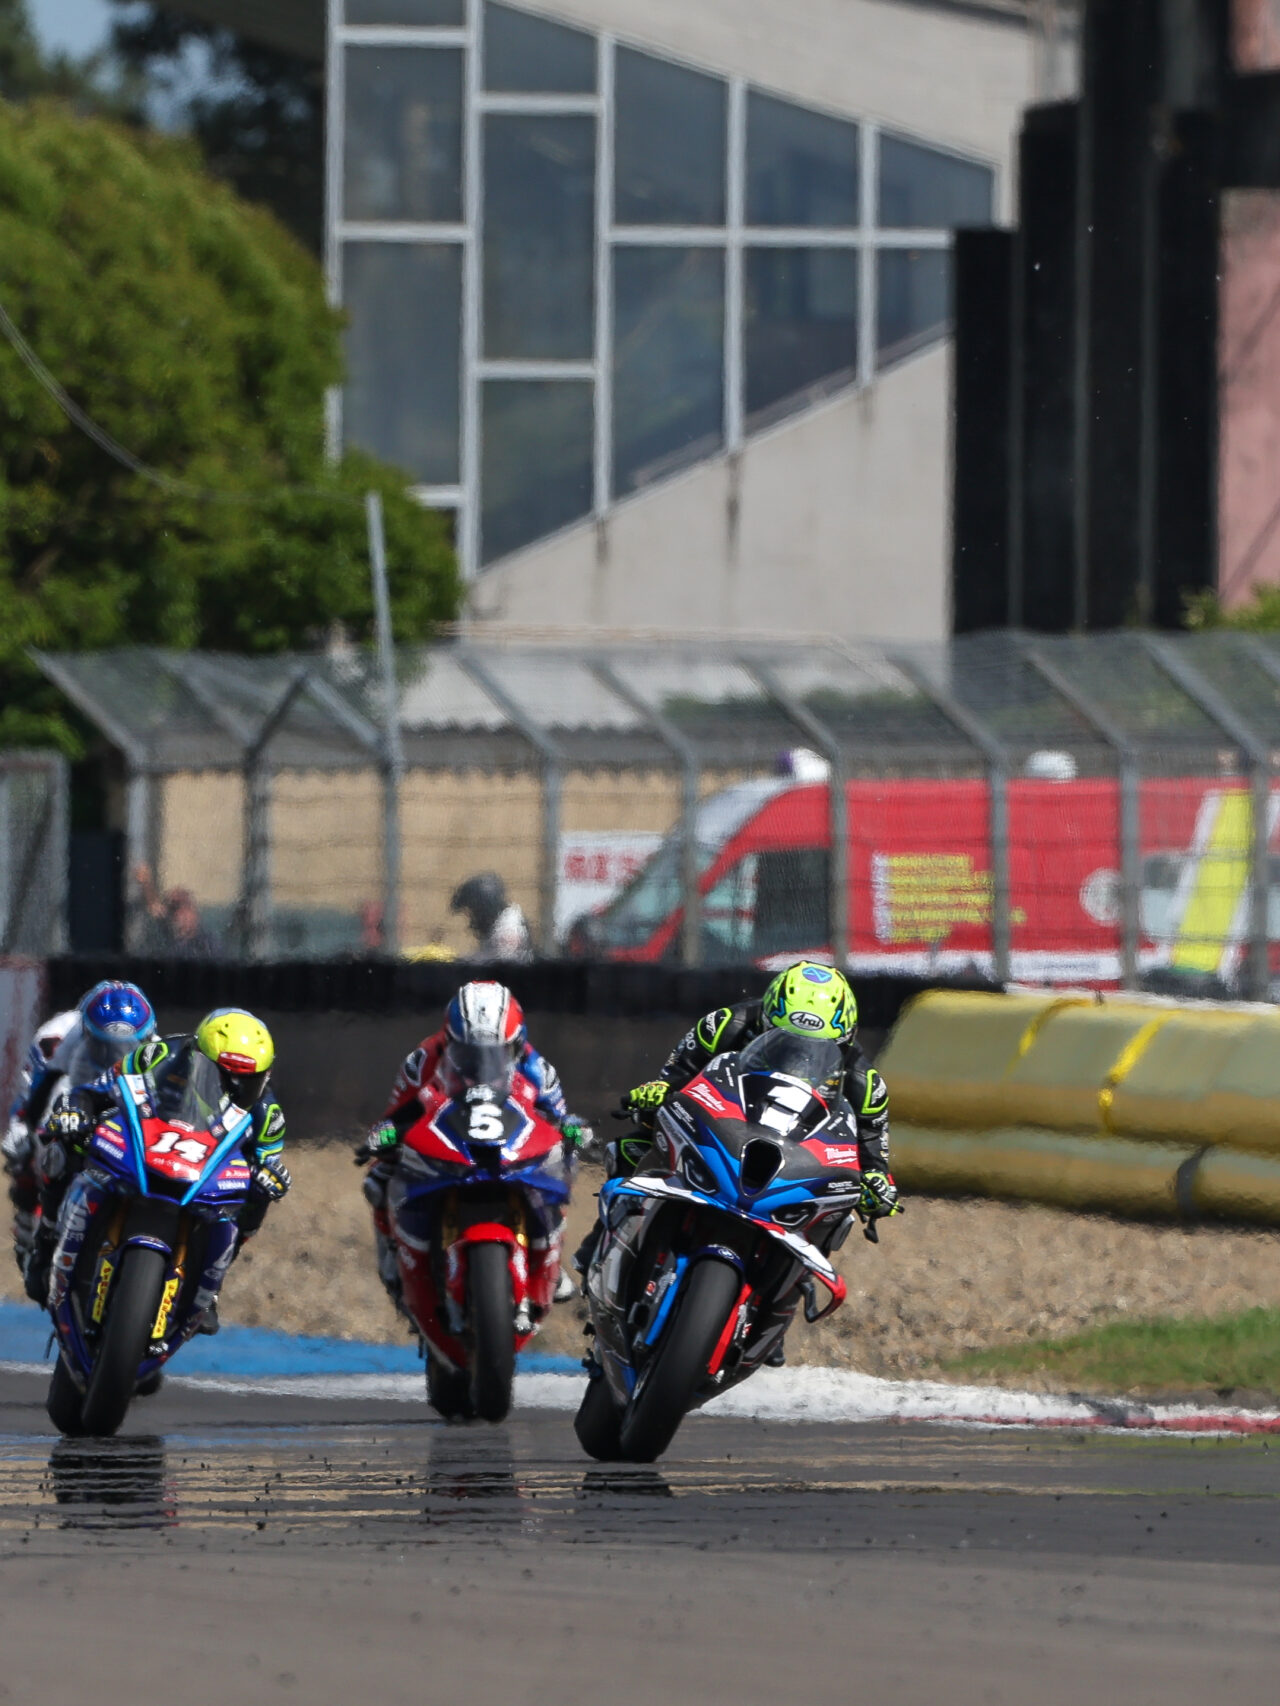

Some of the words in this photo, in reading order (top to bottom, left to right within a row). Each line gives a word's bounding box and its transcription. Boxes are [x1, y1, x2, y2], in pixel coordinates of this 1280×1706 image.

[796, 1013, 821, 1027] Arai
[467, 1101, 505, 1140] 5
[149, 1131, 209, 1164] 14
